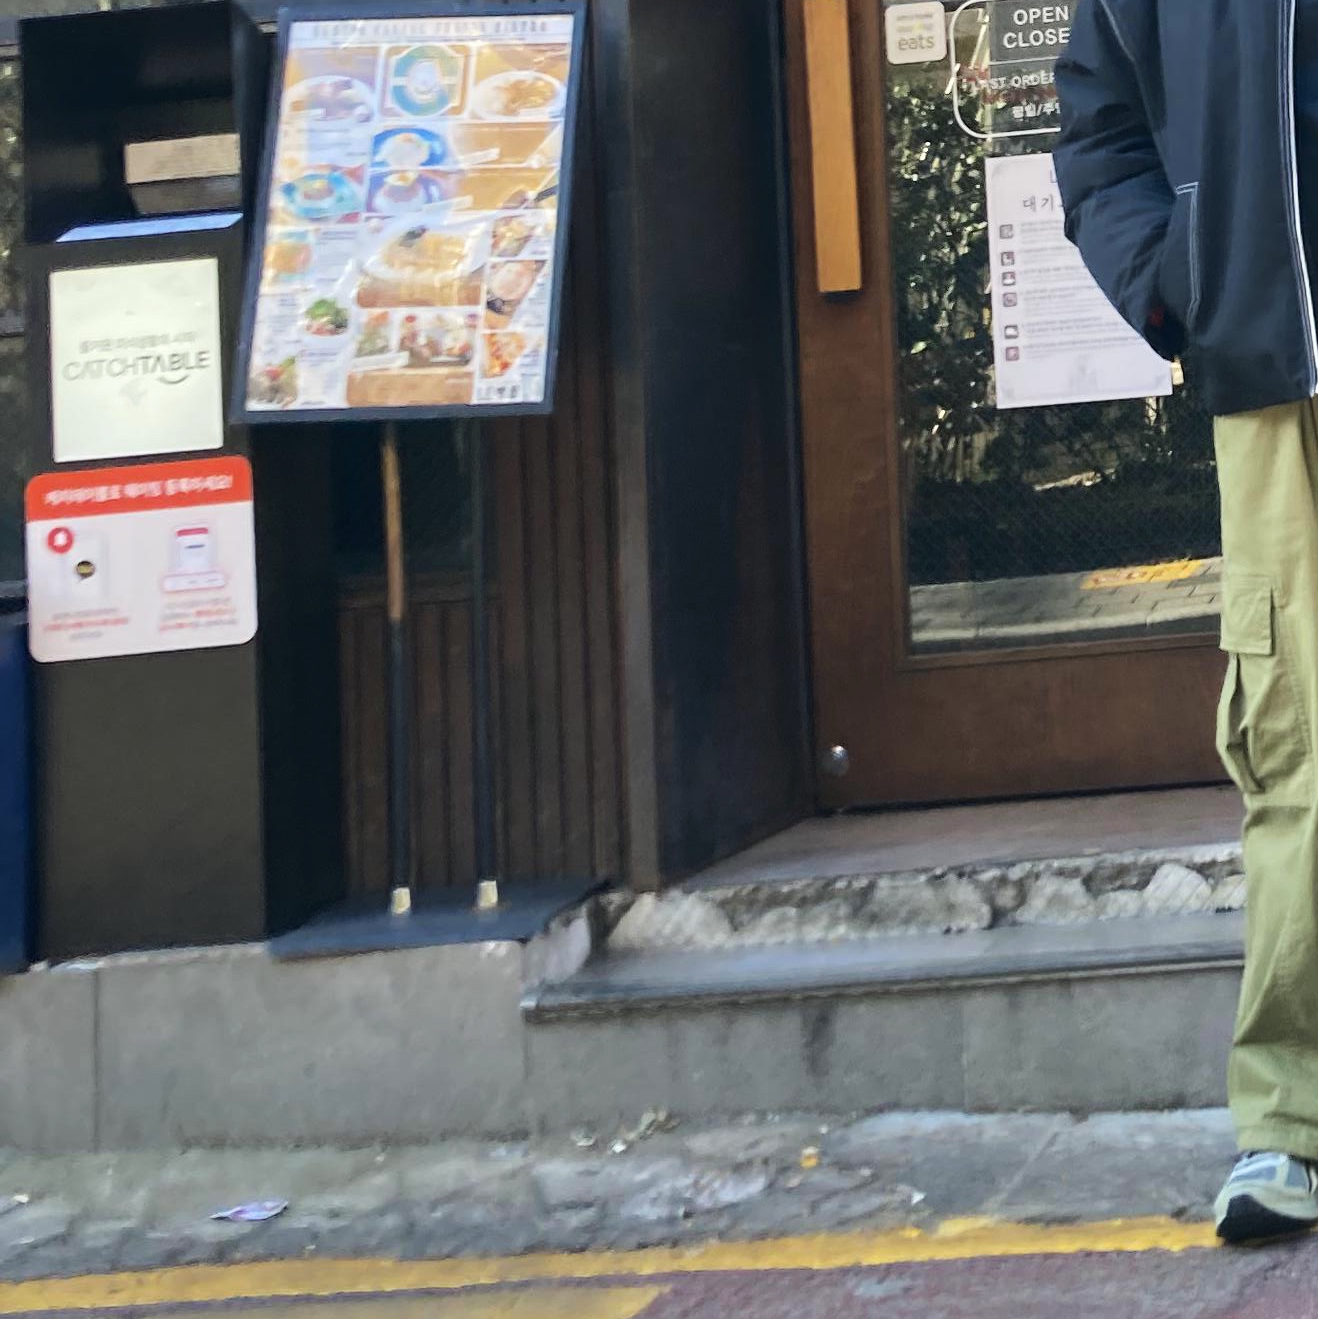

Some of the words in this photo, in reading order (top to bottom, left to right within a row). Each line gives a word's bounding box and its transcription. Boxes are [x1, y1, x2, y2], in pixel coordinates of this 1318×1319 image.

[1013, 6, 1069, 25] OPEN
[898, 35, 934, 50] eats
[1003, 27, 1071, 48] CLOSE
[1023, 194, 1064, 212] 대기
[63, 351, 210, 381] CATCHTABLE
